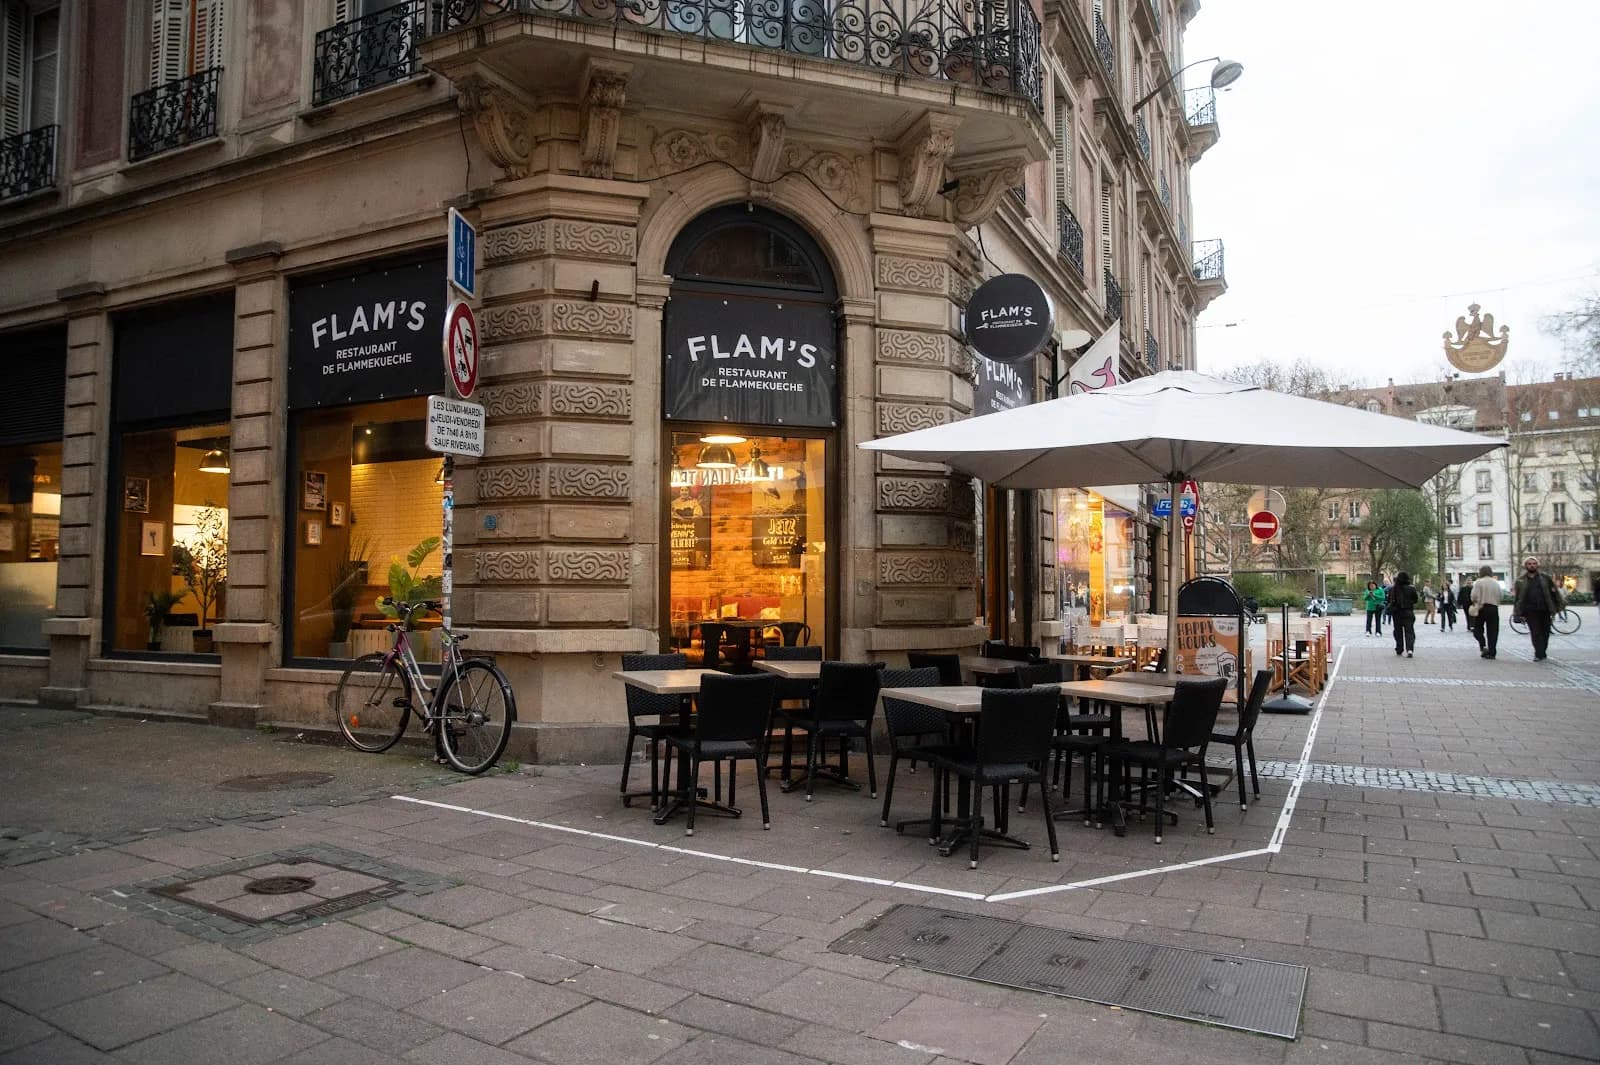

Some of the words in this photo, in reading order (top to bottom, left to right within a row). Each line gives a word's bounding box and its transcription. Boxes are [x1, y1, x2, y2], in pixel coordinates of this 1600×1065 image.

[981, 305, 1033, 321] FLAM'S
[311, 300, 427, 349] FLAM'S
[336, 341, 398, 360] RESTAURANT
[687, 334, 818, 369] FLAM'S
[322, 362, 335, 375] DE
[336, 352, 413, 374] FLAMMEKUECHE
[718, 367, 788, 380] RESTAURANT
[985, 358, 1023, 400] FLAM'S
[701, 378, 716, 388] DE
[719, 379, 804, 392] FLAMMEKUECHE
[433, 400, 445, 411] LES
[434, 412, 481, 430] JEUDI-VENDREDI
[436, 425, 446, 436] DE
[433, 437, 450, 448] SAUF
[1177, 620, 1214, 637] HAPPY
[1178, 634, 1217, 650] HOURS
